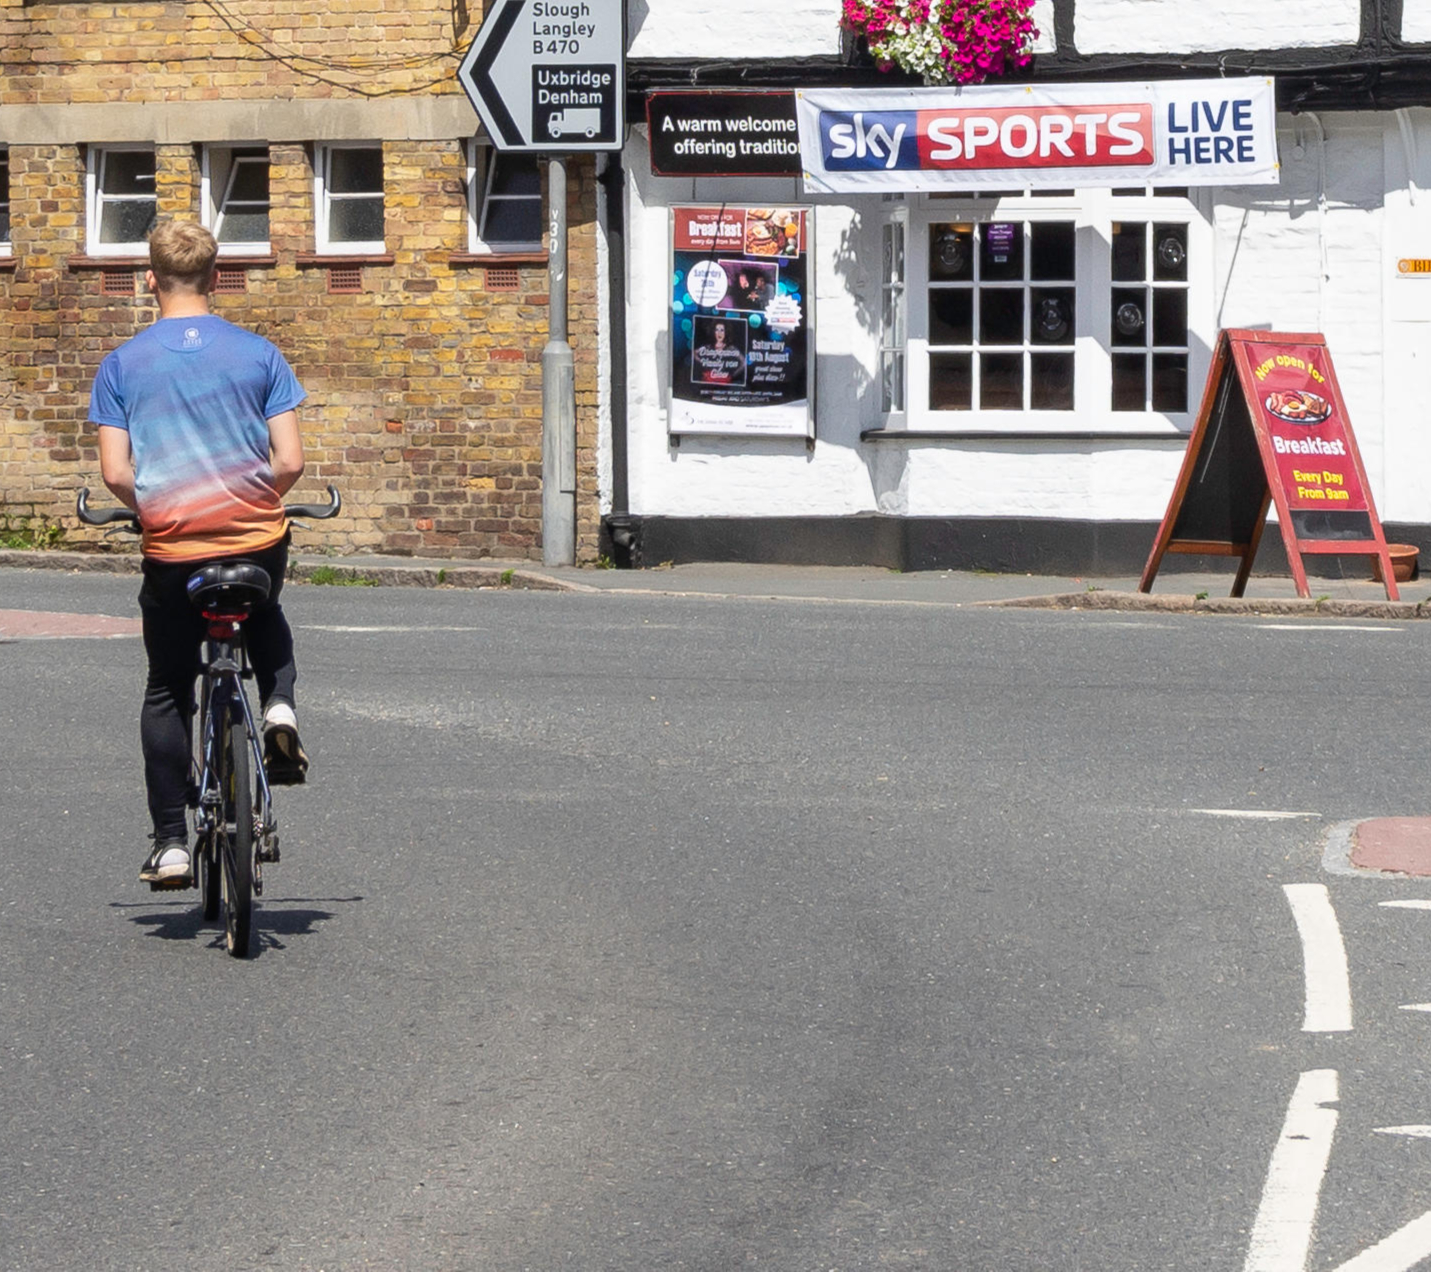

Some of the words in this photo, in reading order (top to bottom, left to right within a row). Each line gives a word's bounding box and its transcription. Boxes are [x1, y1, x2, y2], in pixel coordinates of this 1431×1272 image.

[533, 2, 589, 18] Slough
[533, 21, 595, 37] Langley
[538, 70, 611, 89] Uxbridge
[538, 89, 603, 104] Denham
[662, 115, 674, 132] A
[677, 118, 722, 132] warm
[725, 115, 796, 132] welcome
[1169, 99, 1253, 133] LIVE
[674, 138, 736, 158] offering
[831, 113, 907, 169] sky
[930, 111, 1145, 160] SPORTS
[1169, 134, 1255, 164] HERE
[1255, 359, 1276, 381] Now
[1276, 354, 1305, 371] open
[1307, 363, 1325, 384] for
[1273, 436, 1346, 455] Breakfast
[1293, 470, 1321, 484] Every
[1323, 471, 1343, 485] Day
[1298, 486, 1324, 500] From
[1327, 488, 1349, 500] 9am
